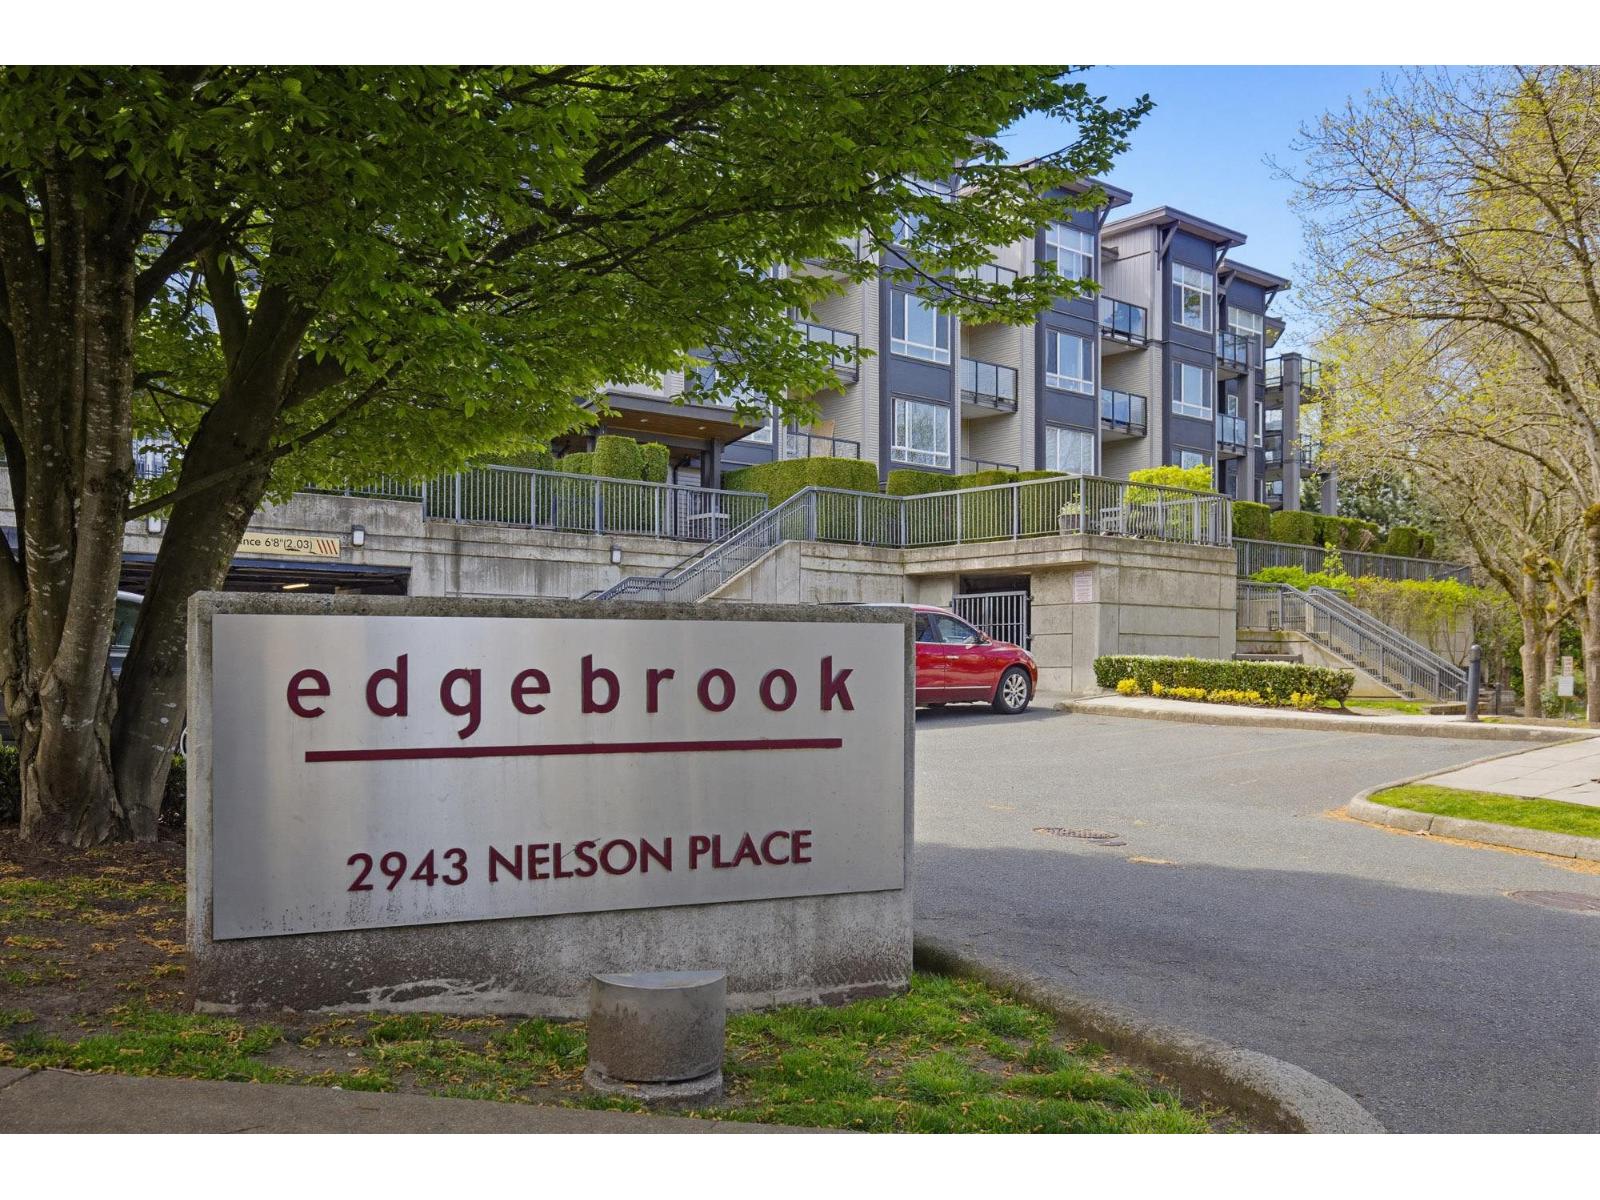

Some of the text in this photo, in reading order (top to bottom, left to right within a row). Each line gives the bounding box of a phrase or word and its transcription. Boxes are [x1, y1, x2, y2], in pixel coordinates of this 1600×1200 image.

[287, 654, 854, 740] edgebrook
[347, 830, 813, 892] 2943 NELSON PLACE
